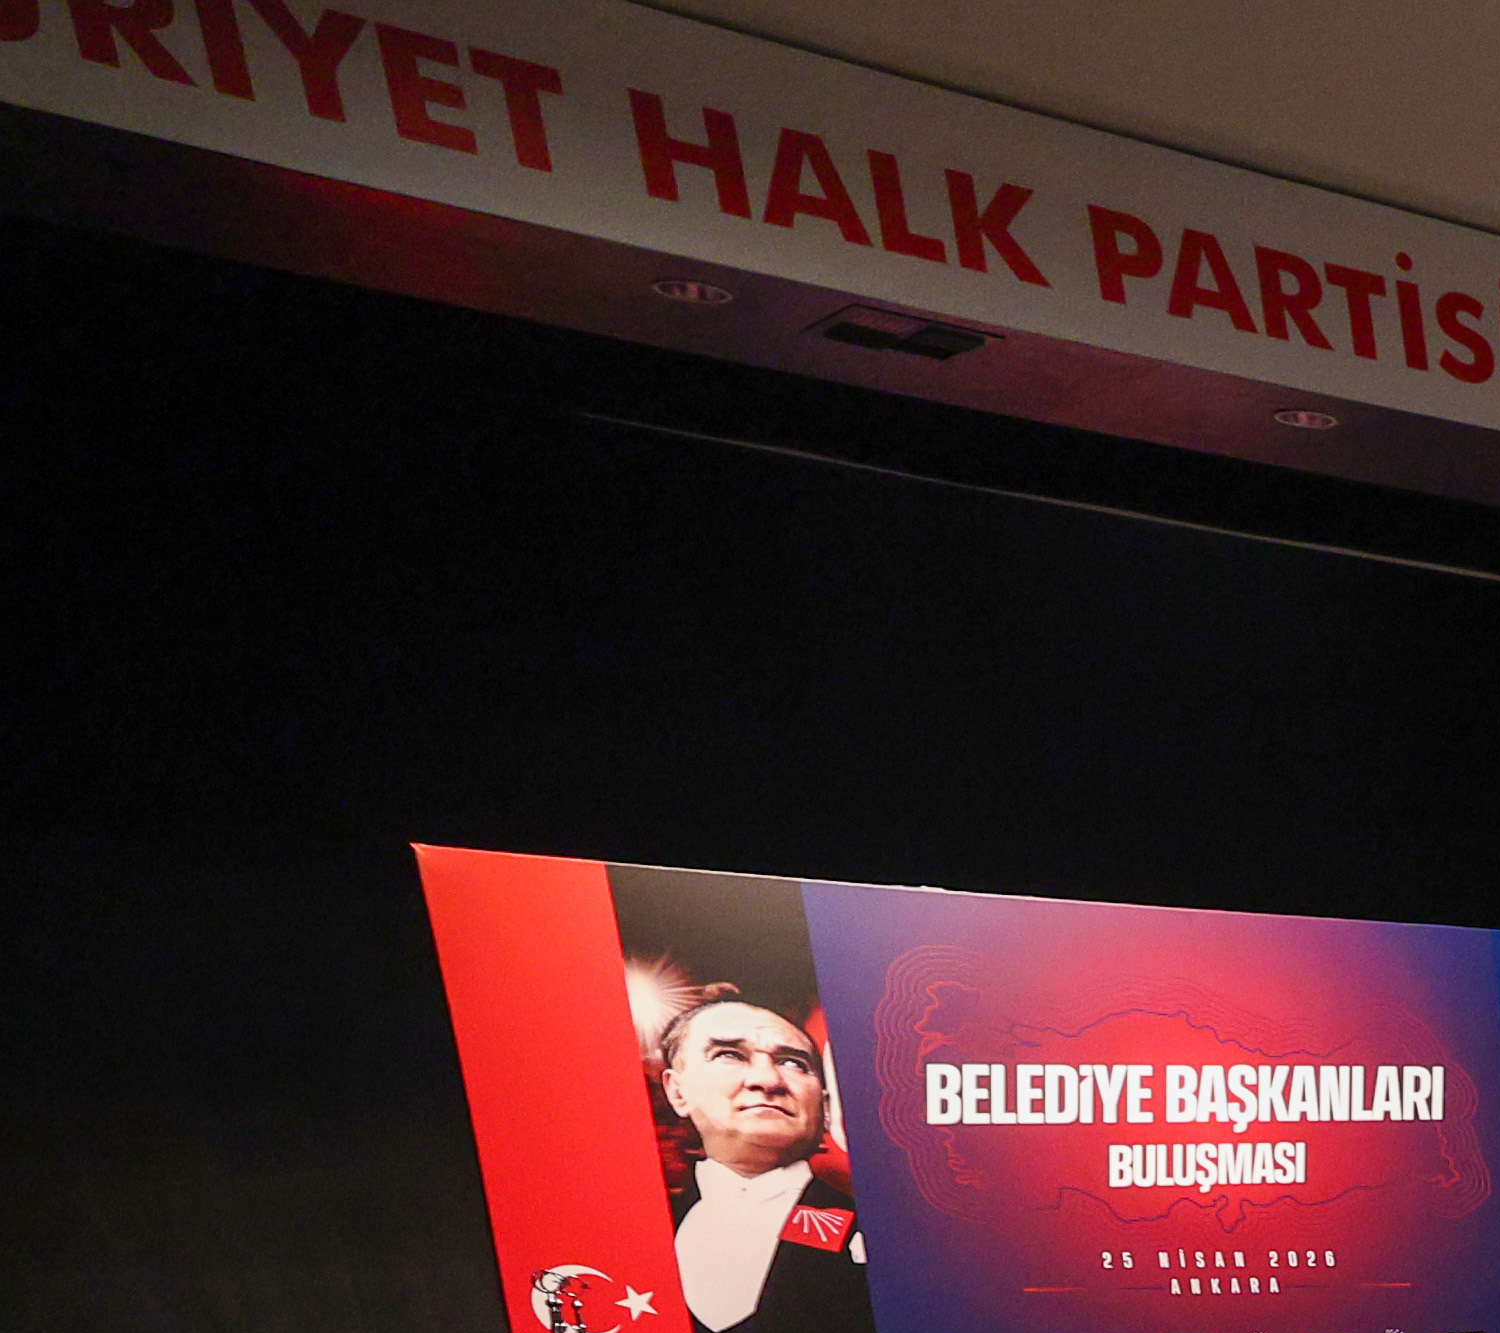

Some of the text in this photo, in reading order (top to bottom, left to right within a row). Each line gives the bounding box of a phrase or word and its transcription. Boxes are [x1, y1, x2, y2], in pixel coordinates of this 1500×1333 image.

[627, 88, 1051, 288] HALK
[925, 1062, 1445, 1133] BELEDİYE BAŞKANLARI
[1108, 1142, 1306, 1193] BULUŞMASI
[1101, 1248, 1336, 1269] 25 NİSAN 2026
[1170, 1277, 1281, 1295] ANKARA
